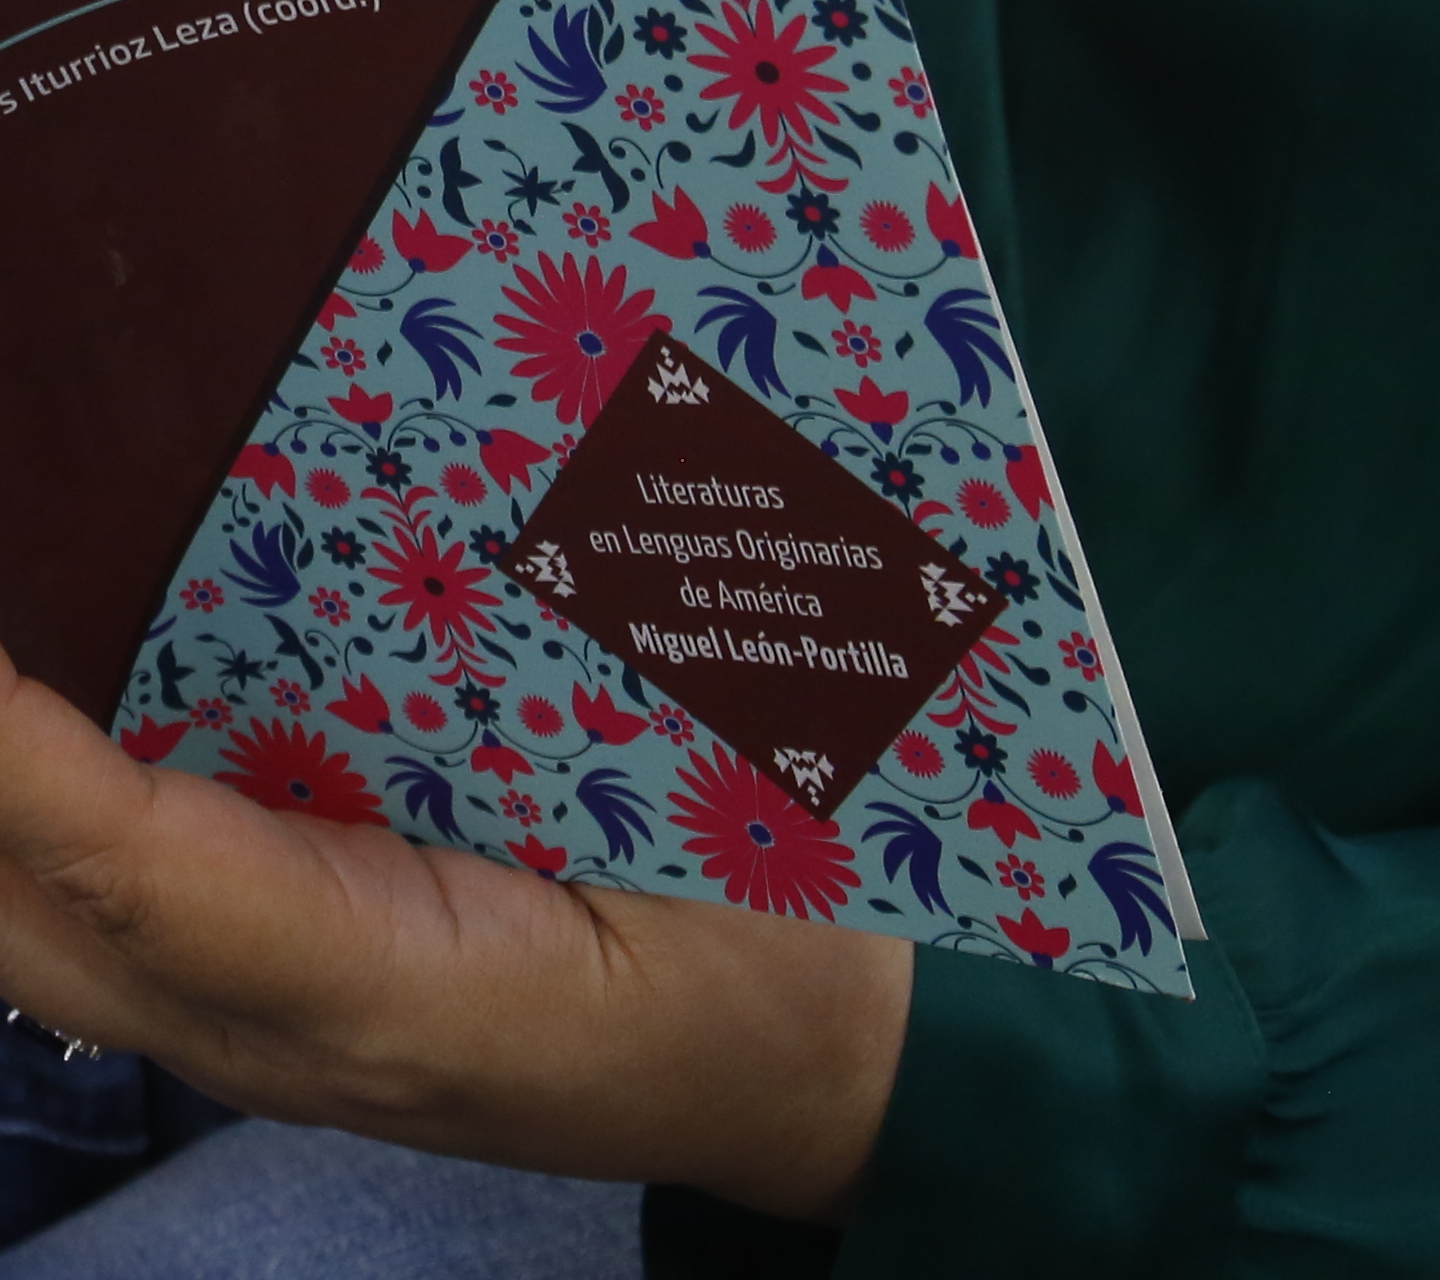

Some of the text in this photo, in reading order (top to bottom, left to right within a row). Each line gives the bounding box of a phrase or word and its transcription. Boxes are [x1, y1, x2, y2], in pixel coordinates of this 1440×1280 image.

[17, 33, 153, 105] Iturrioz
[152, 8, 239, 53] Leza
[637, 473, 785, 510] Literaturas
[590, 524, 883, 571] en Lenguas Originarias
[680, 576, 823, 617] de América
[629, 623, 909, 679] Miguel León-Portilla
